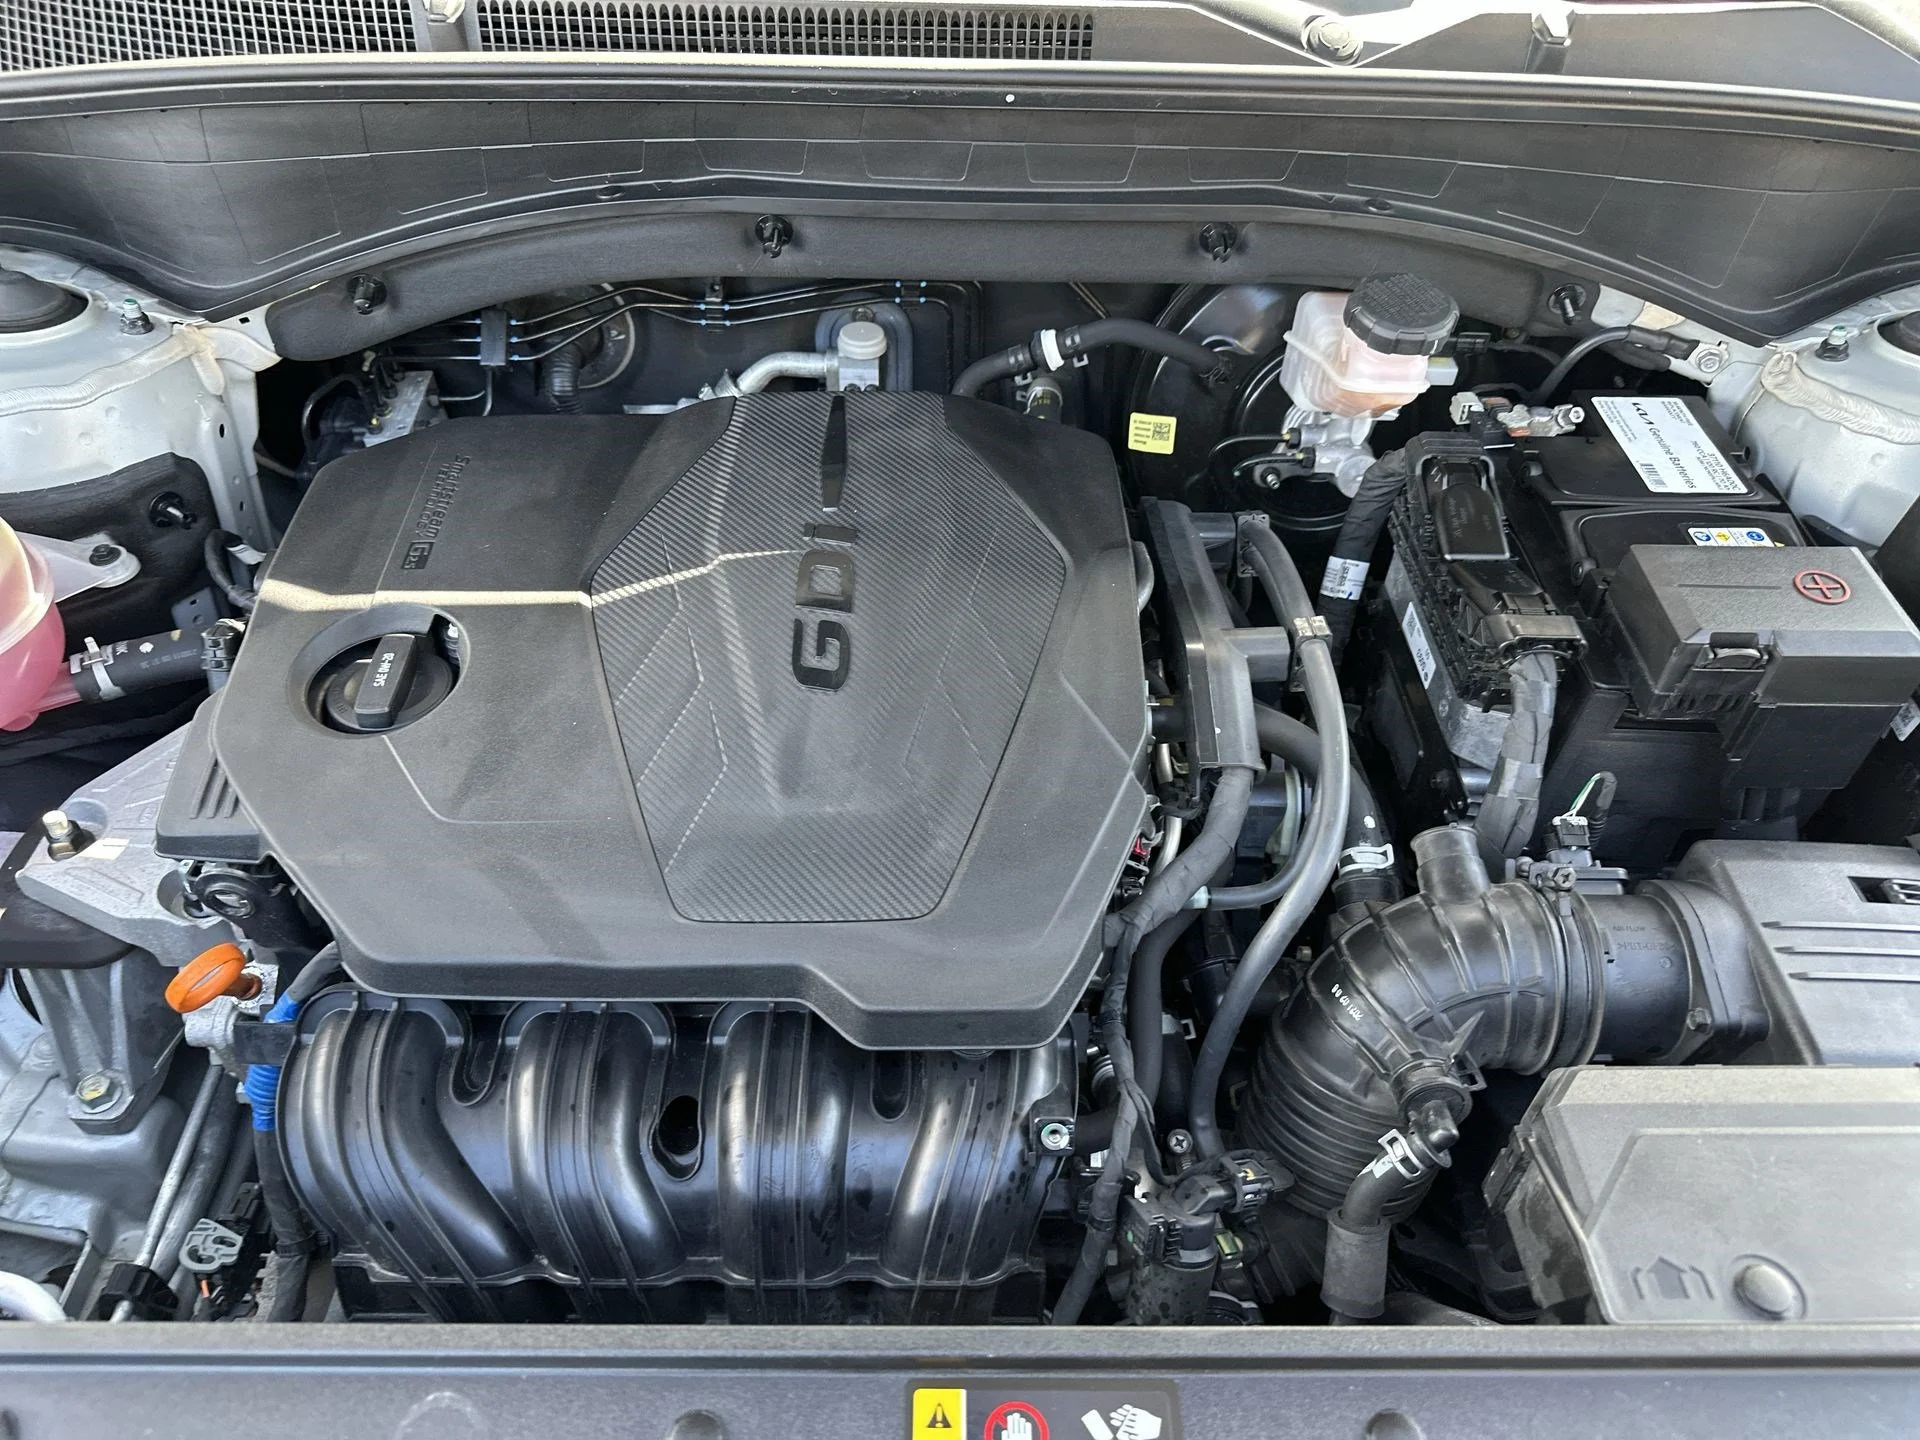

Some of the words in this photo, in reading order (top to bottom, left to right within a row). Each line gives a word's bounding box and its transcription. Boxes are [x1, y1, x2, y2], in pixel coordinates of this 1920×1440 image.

[1631, 402, 1655, 425] KIA
[1649, 427, 1674, 455] Genuine
[1669, 456, 1697, 488] Batteries
[425, 454, 471, 539] Smartstream
[373, 673, 388, 687] SAE
[378, 652, 395, 673] 0W-20
